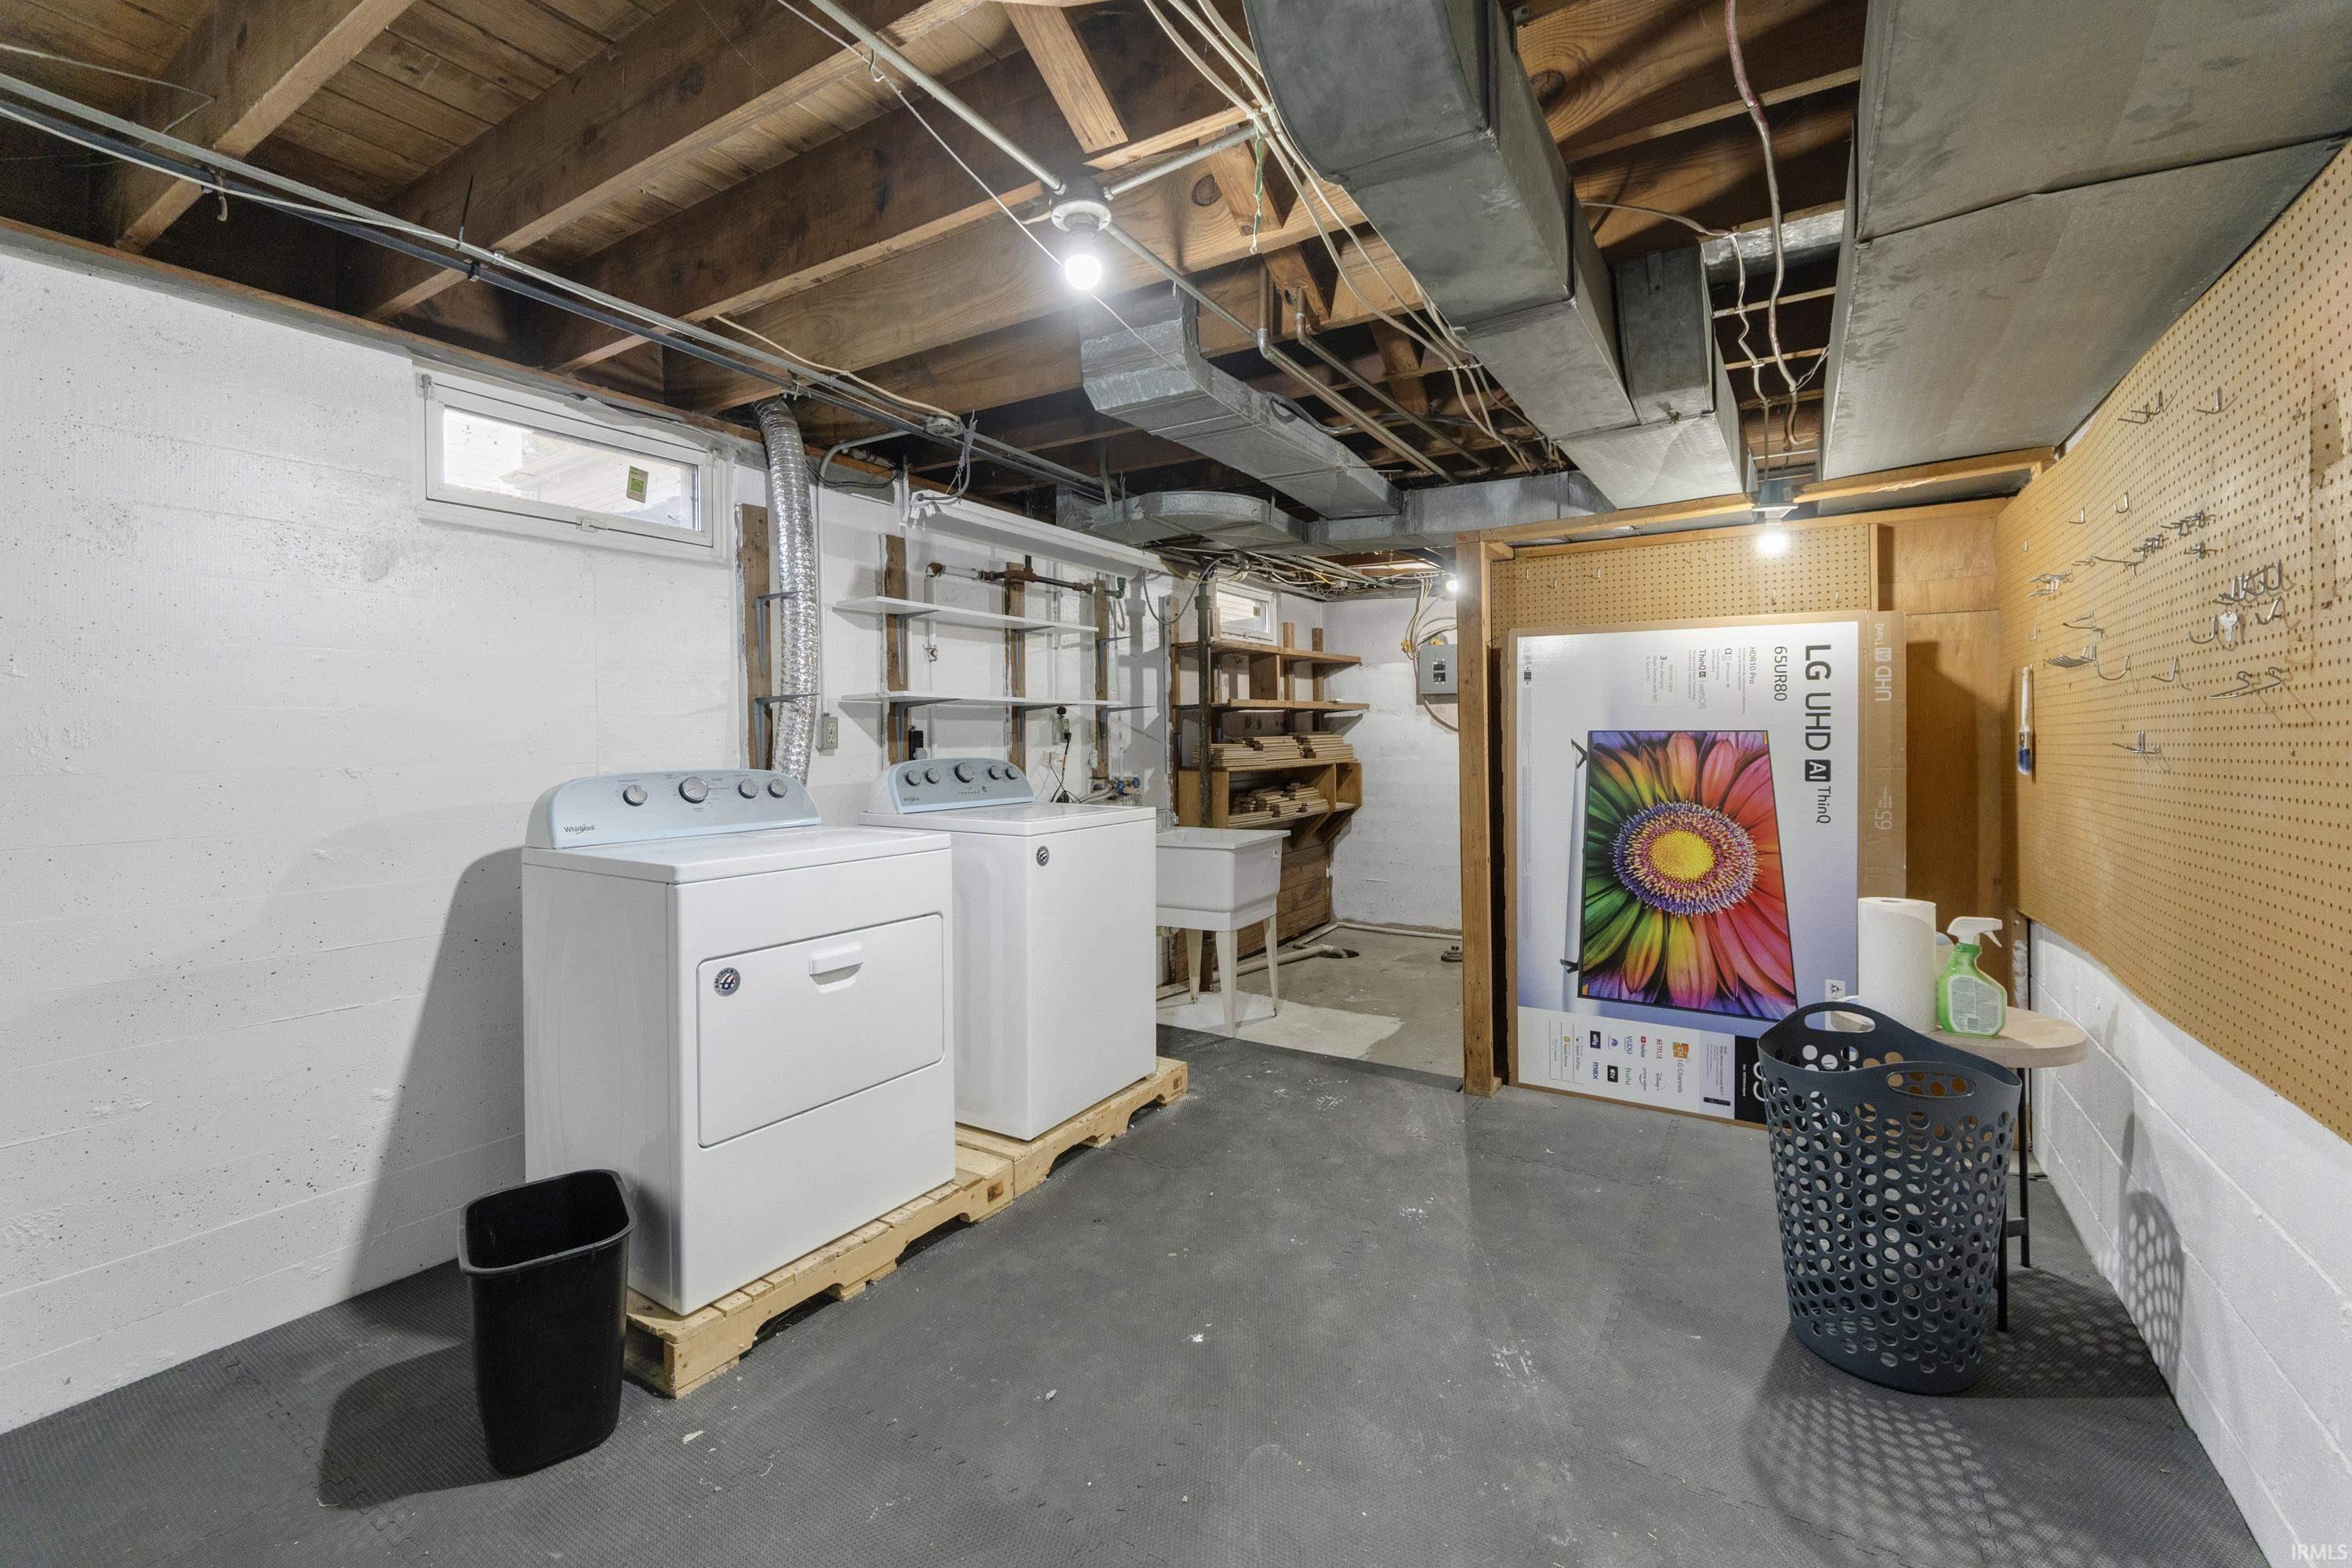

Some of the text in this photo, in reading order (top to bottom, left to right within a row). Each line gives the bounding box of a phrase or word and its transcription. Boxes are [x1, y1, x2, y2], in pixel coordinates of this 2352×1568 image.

[1875, 623, 1886, 646] ThinQ
[1698, 649, 1707, 671] ThinQ
[1773, 646, 1788, 702] 65UR80
[1875, 666, 1892, 702] UHD
[1698, 684, 1707, 710] webOS
[1805, 644, 1831, 824] LG UHD AI ThinQ
[564, 825, 596, 835] Whirlpool
[1677, 1059, 1684, 1068] LG
